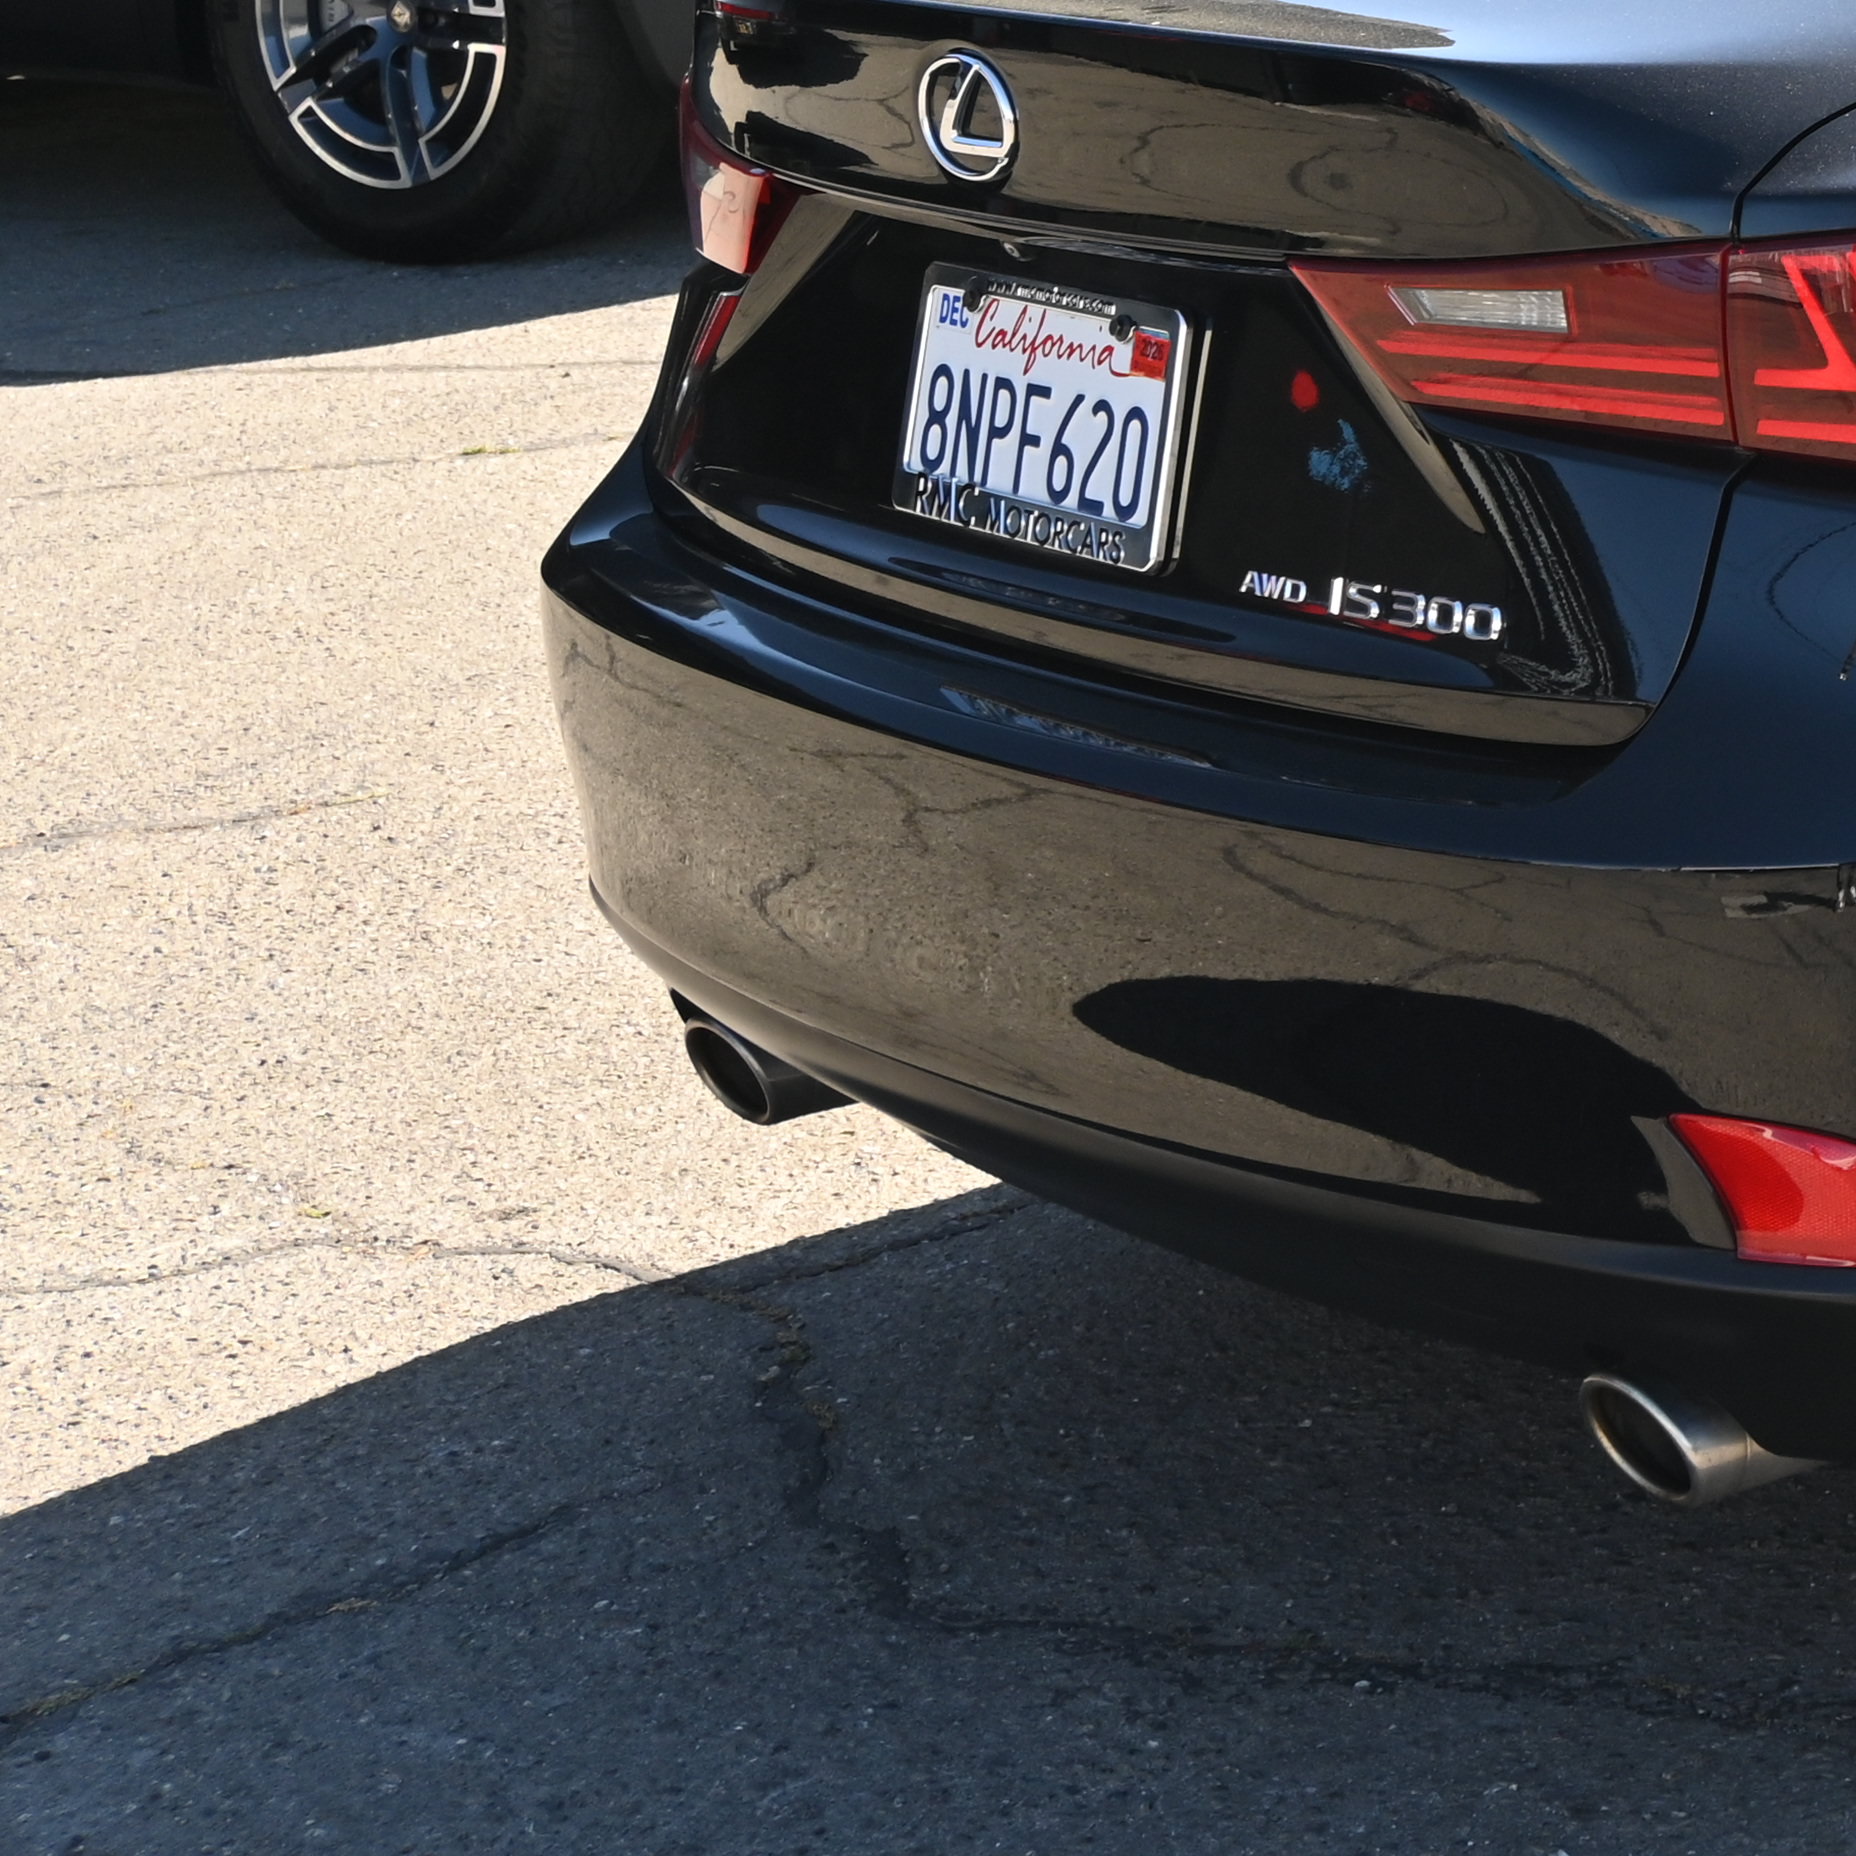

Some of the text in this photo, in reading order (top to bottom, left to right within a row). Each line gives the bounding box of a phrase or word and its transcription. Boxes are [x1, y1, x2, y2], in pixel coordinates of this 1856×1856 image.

[938, 292, 970, 329] DEC
[974, 297, 1131, 378] California
[919, 362, 1150, 523] 8NPF620
[914, 471, 1127, 566] RMC MOTORCARS
[1239, 569, 1307, 604] AWD
